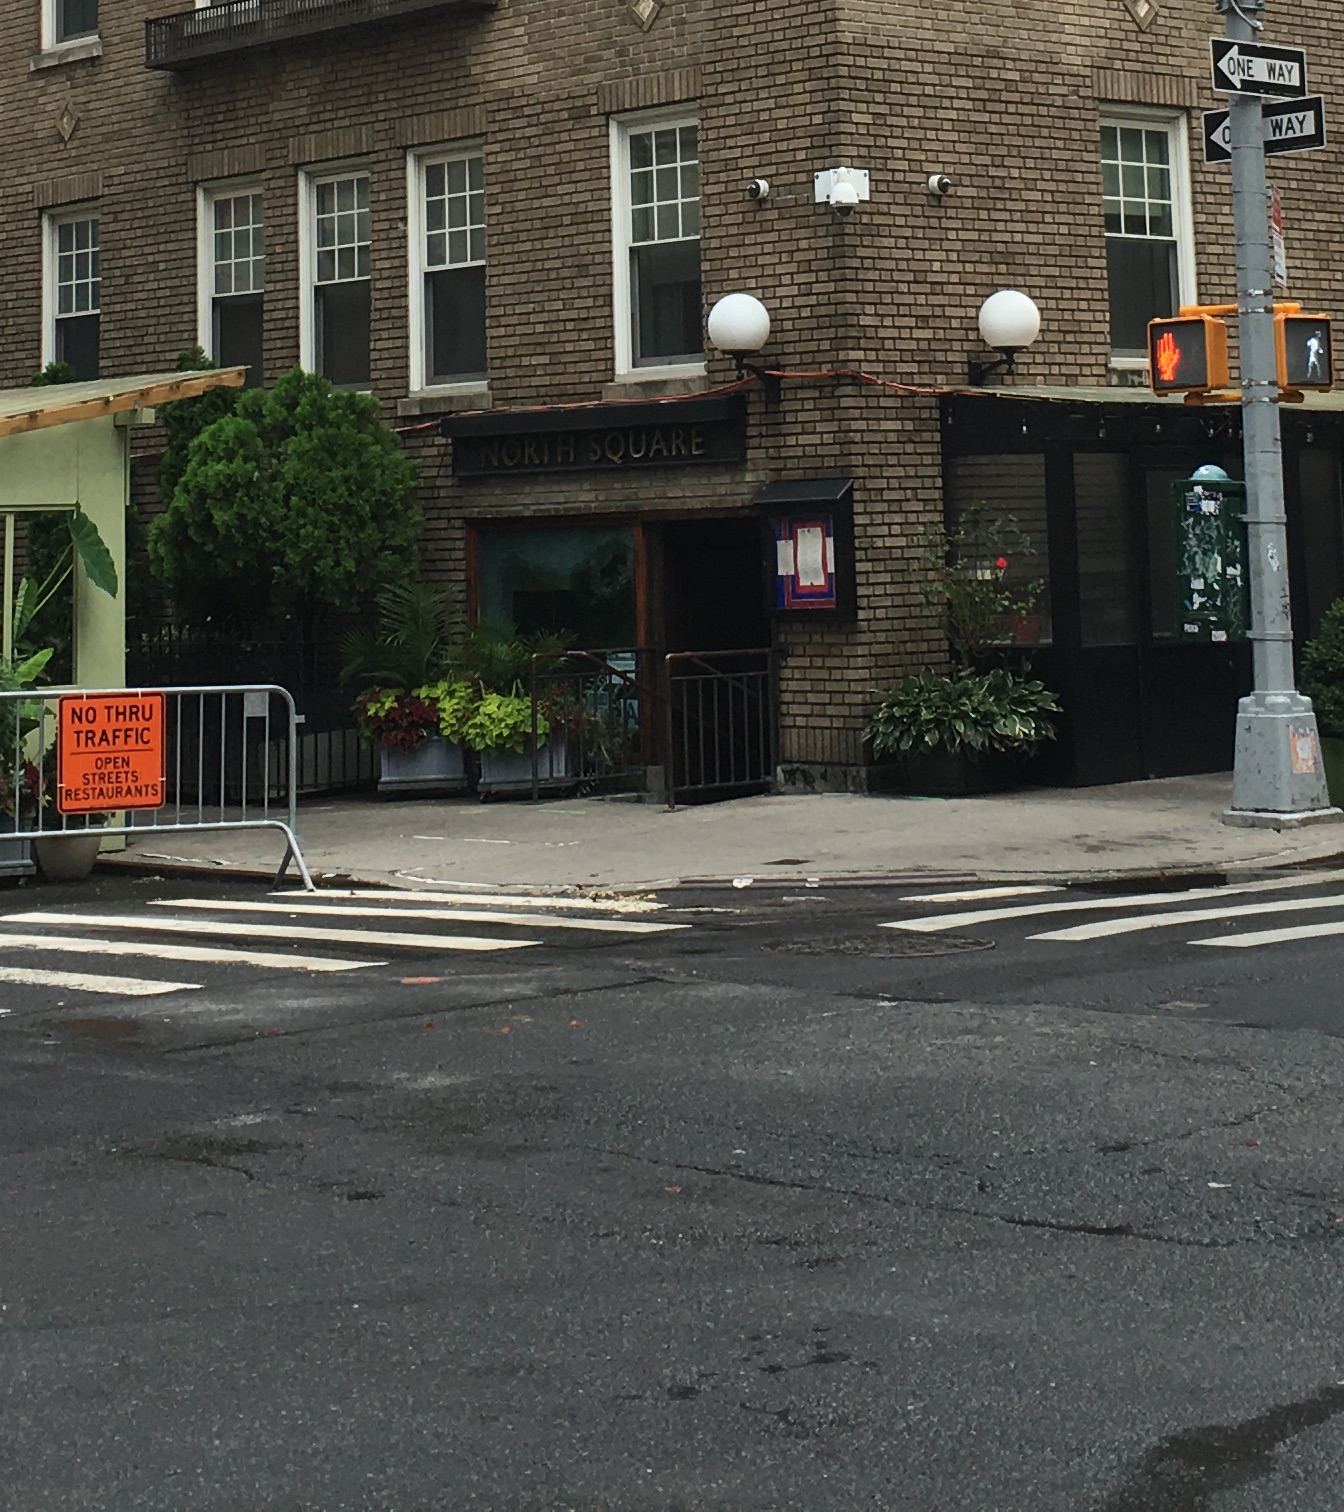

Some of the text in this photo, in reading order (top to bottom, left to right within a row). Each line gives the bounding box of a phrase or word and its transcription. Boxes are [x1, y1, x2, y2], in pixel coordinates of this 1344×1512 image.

[1227, 56, 1294, 83] ONE WAY
[1270, 114, 1307, 138] WAY
[480, 424, 706, 467] NORTH SQUARE
[71, 703, 154, 725] NO THRU
[73, 727, 151, 748] TRAFFIC
[95, 756, 130, 770] OPEN
[82, 770, 139, 786] STREETS
[64, 783, 159, 802] RESTAURANTS
